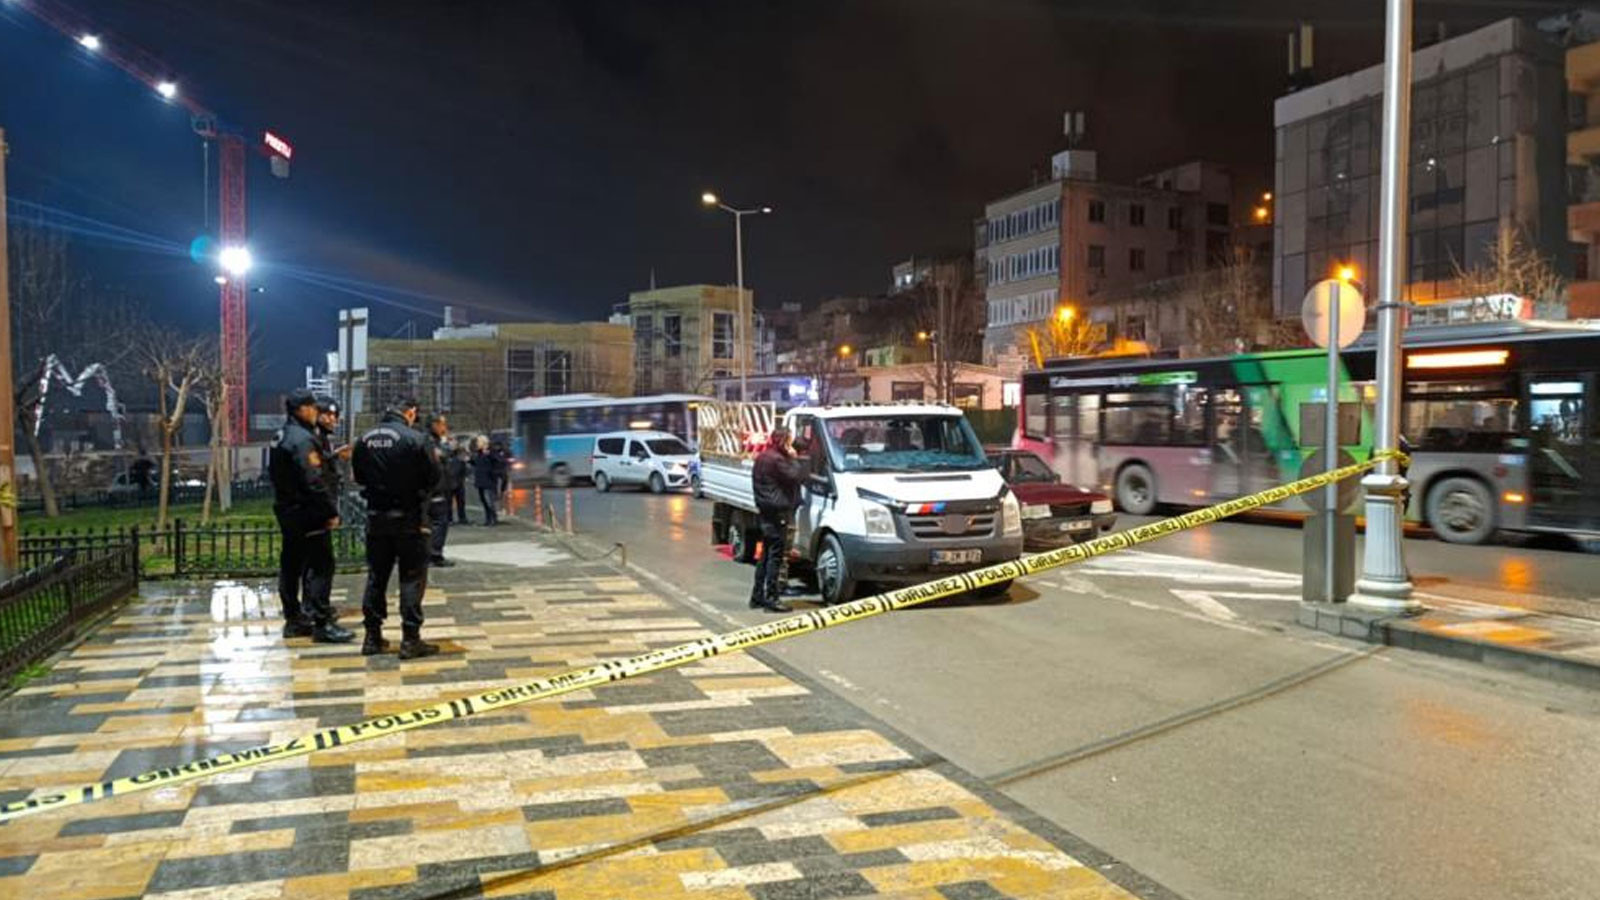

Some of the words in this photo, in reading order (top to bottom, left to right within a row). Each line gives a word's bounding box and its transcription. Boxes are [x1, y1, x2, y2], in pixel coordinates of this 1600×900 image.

[350, 708, 441, 735] POLIS
[826, 601, 876, 620] POLIS
[975, 565, 1014, 583] POLIS
